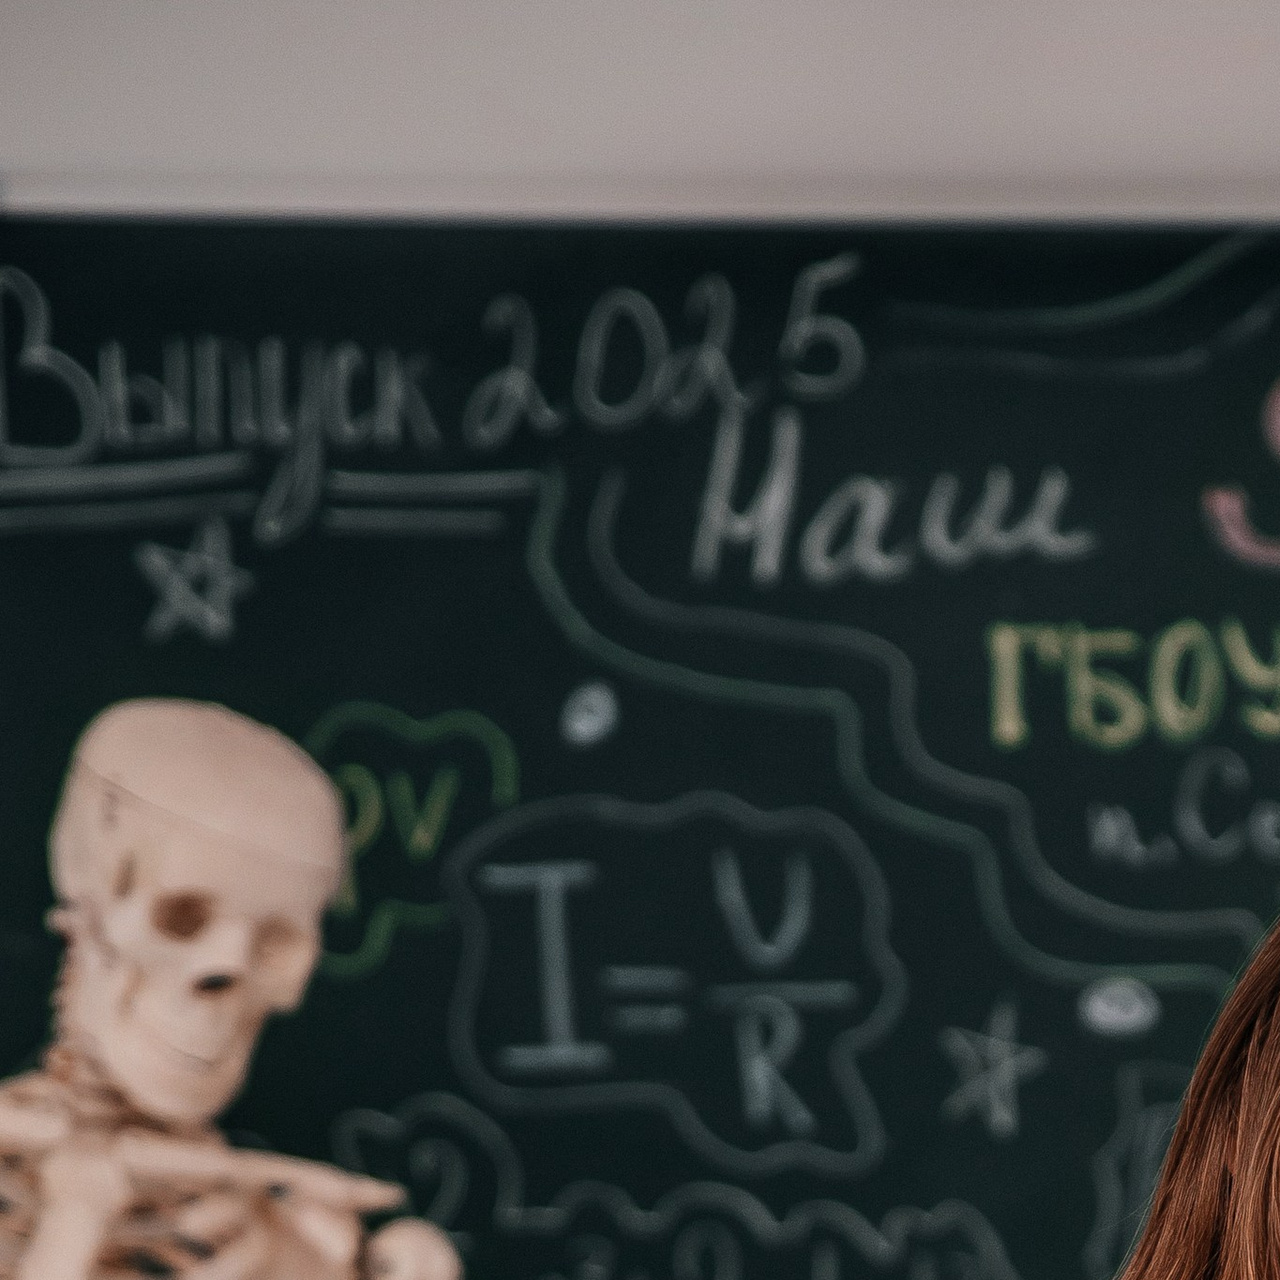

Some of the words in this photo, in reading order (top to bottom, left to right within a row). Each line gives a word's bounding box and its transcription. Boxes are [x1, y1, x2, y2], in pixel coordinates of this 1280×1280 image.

[0, 265, 445, 545] Выпуск
[462, 252, 868, 450] 2025
[690, 400, 1098, 584] Наш
